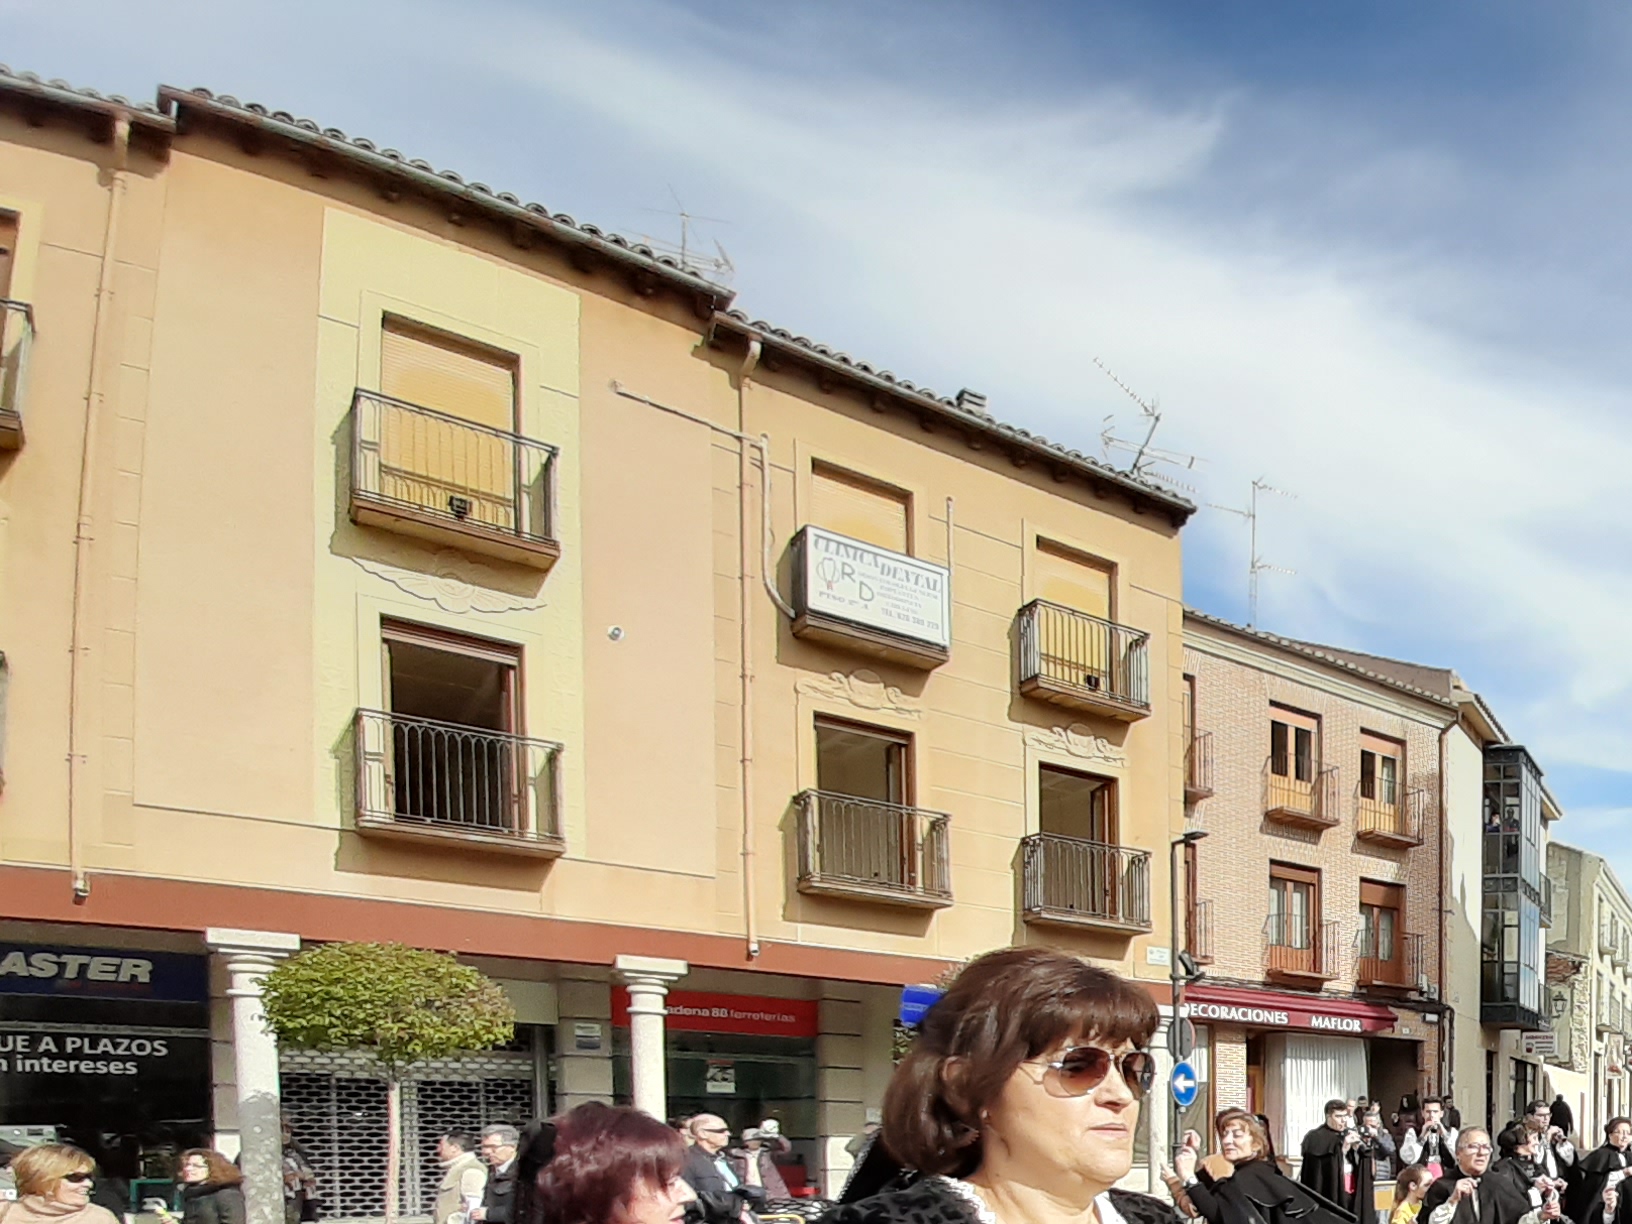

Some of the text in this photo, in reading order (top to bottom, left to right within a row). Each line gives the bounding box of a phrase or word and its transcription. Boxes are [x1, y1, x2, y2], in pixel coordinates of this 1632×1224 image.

[841, 561, 856, 583] R
[880, 562, 941, 592] DENTAL
[859, 580, 875, 602] D
[0, 951, 153, 983] ASTER
[711, 1007, 728, 1018] 88
[1311, 1015, 1362, 1032] MAFLOR
[37, 1036, 59, 1053] A
[66, 1037, 169, 1057] PLAZOS
[16, 1055, 138, 1075] intereses
